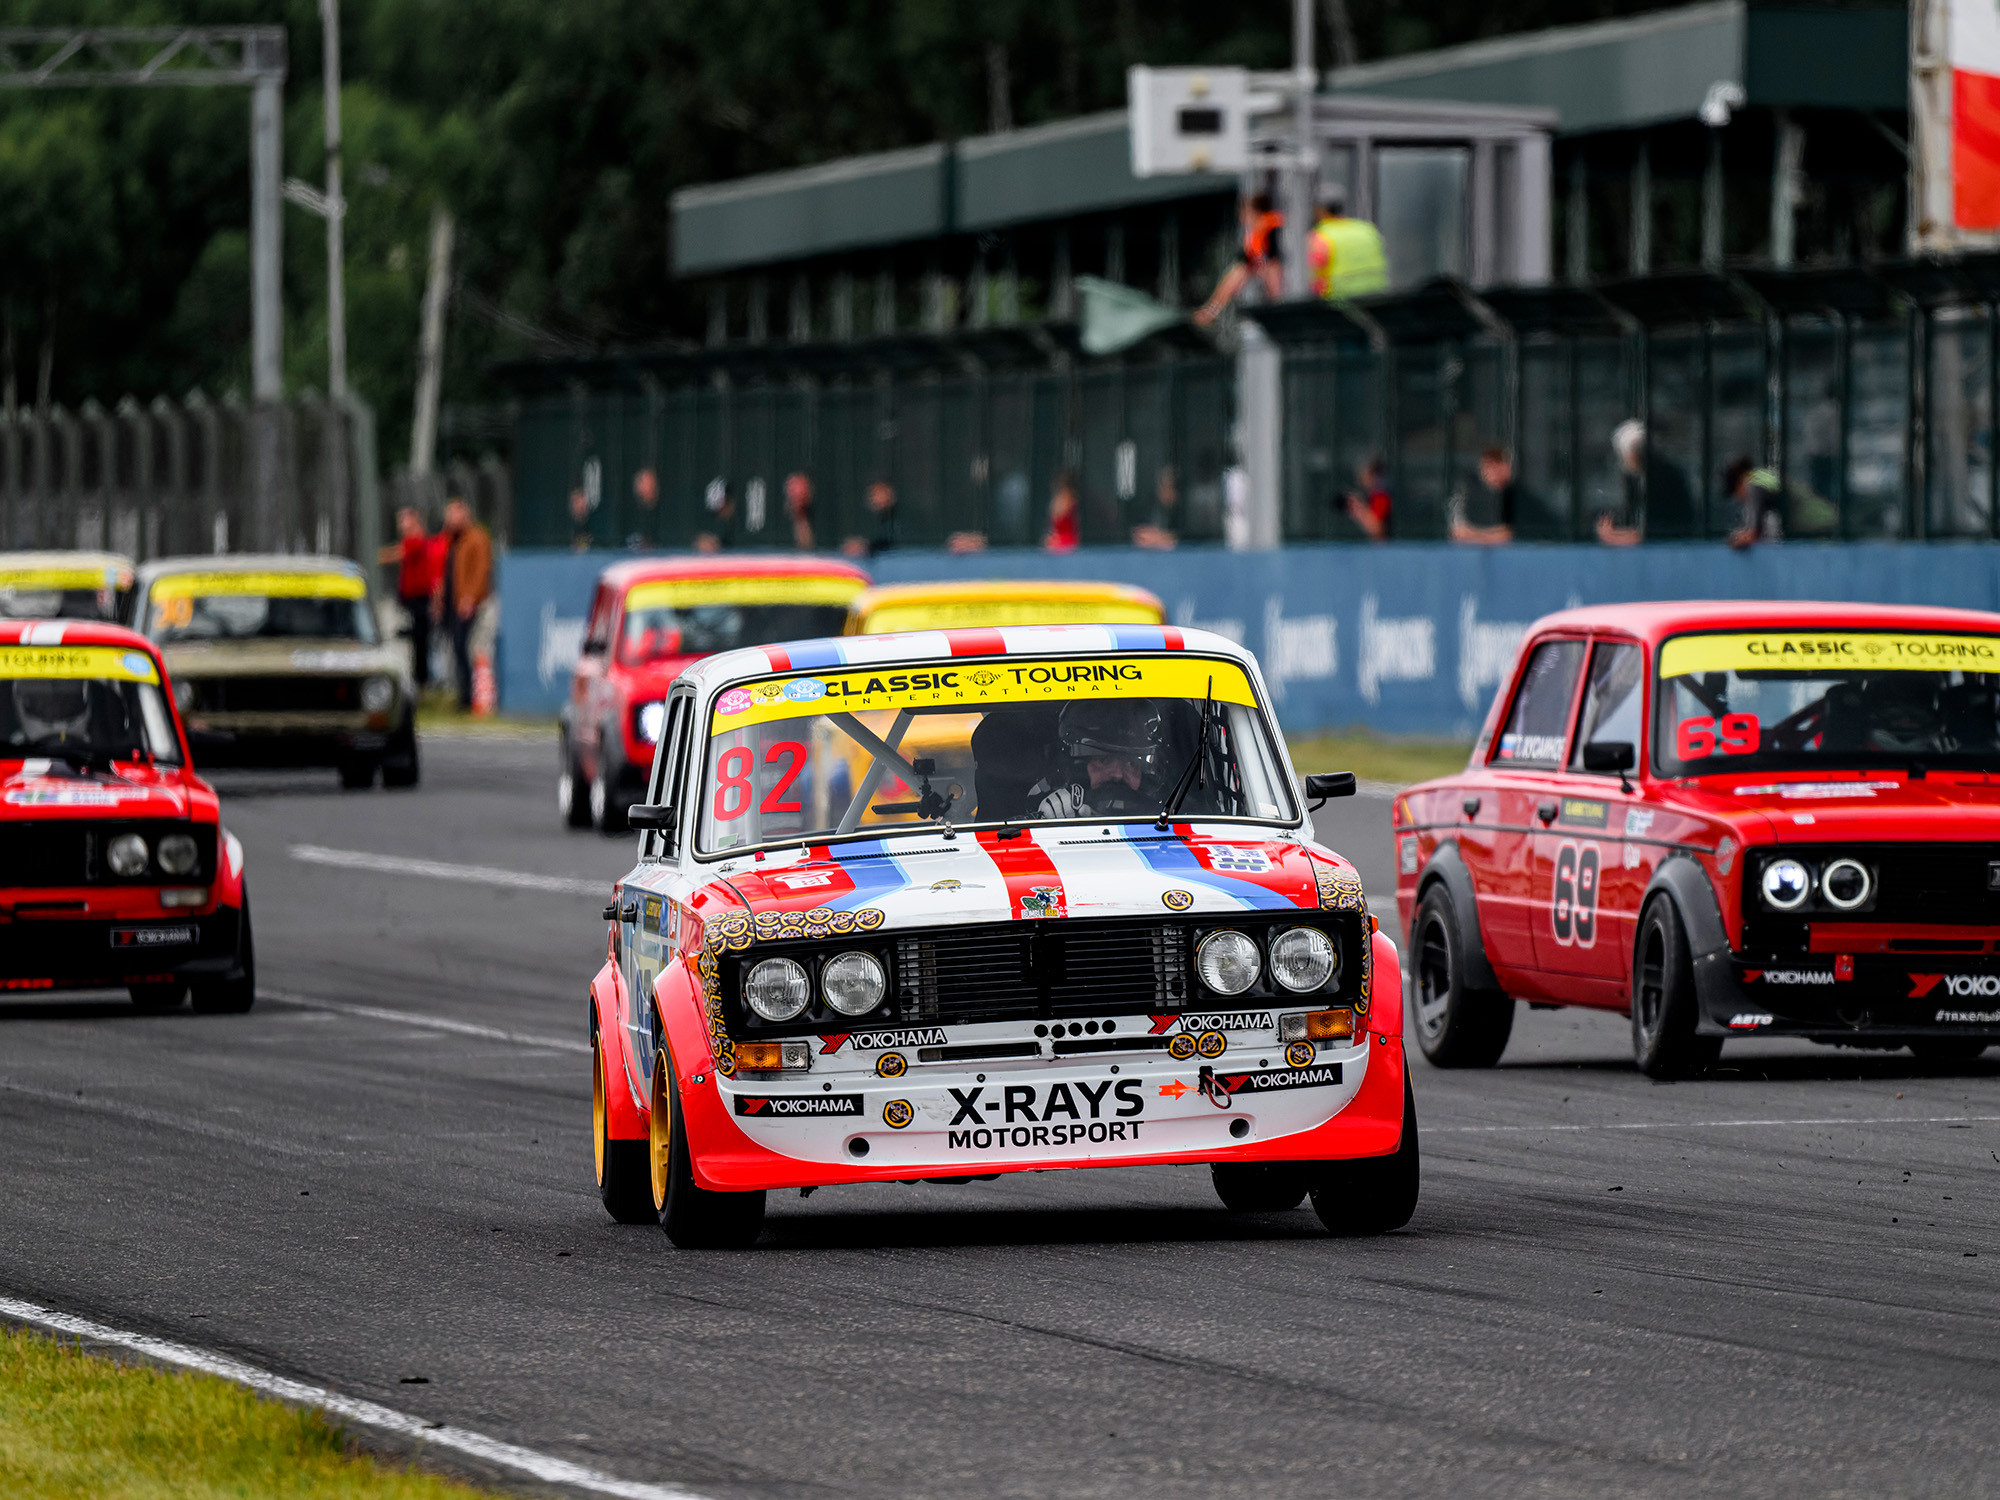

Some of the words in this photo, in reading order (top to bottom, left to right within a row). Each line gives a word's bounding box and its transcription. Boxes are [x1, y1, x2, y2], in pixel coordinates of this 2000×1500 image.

[1747, 641, 1854, 656] CLASSIC
[1892, 641, 1994, 658] TOURING
[824, 671, 959, 697] CLASSIC
[1008, 664, 1142, 684] TOURING
[844, 684, 1123, 706] INTERNATIONAL
[1676, 713, 1760, 762] 69
[713, 740, 808, 821] 82
[1552, 838, 1601, 949] 69
[1763, 970, 1835, 985] YOKOHAMA
[1944, 974, 2000, 996] YOKO
[1179, 1013, 1273, 1031] YOKOHAMA
[850, 1029, 946, 1049] YOKOHAMA
[1250, 1069, 1334, 1088] YOKOHAMA
[769, 1099, 855, 1113] YOKOHAMA
[948, 1080, 1144, 1126] X-RAYS
[948, 1121, 1144, 1149] MOTORSPORT
